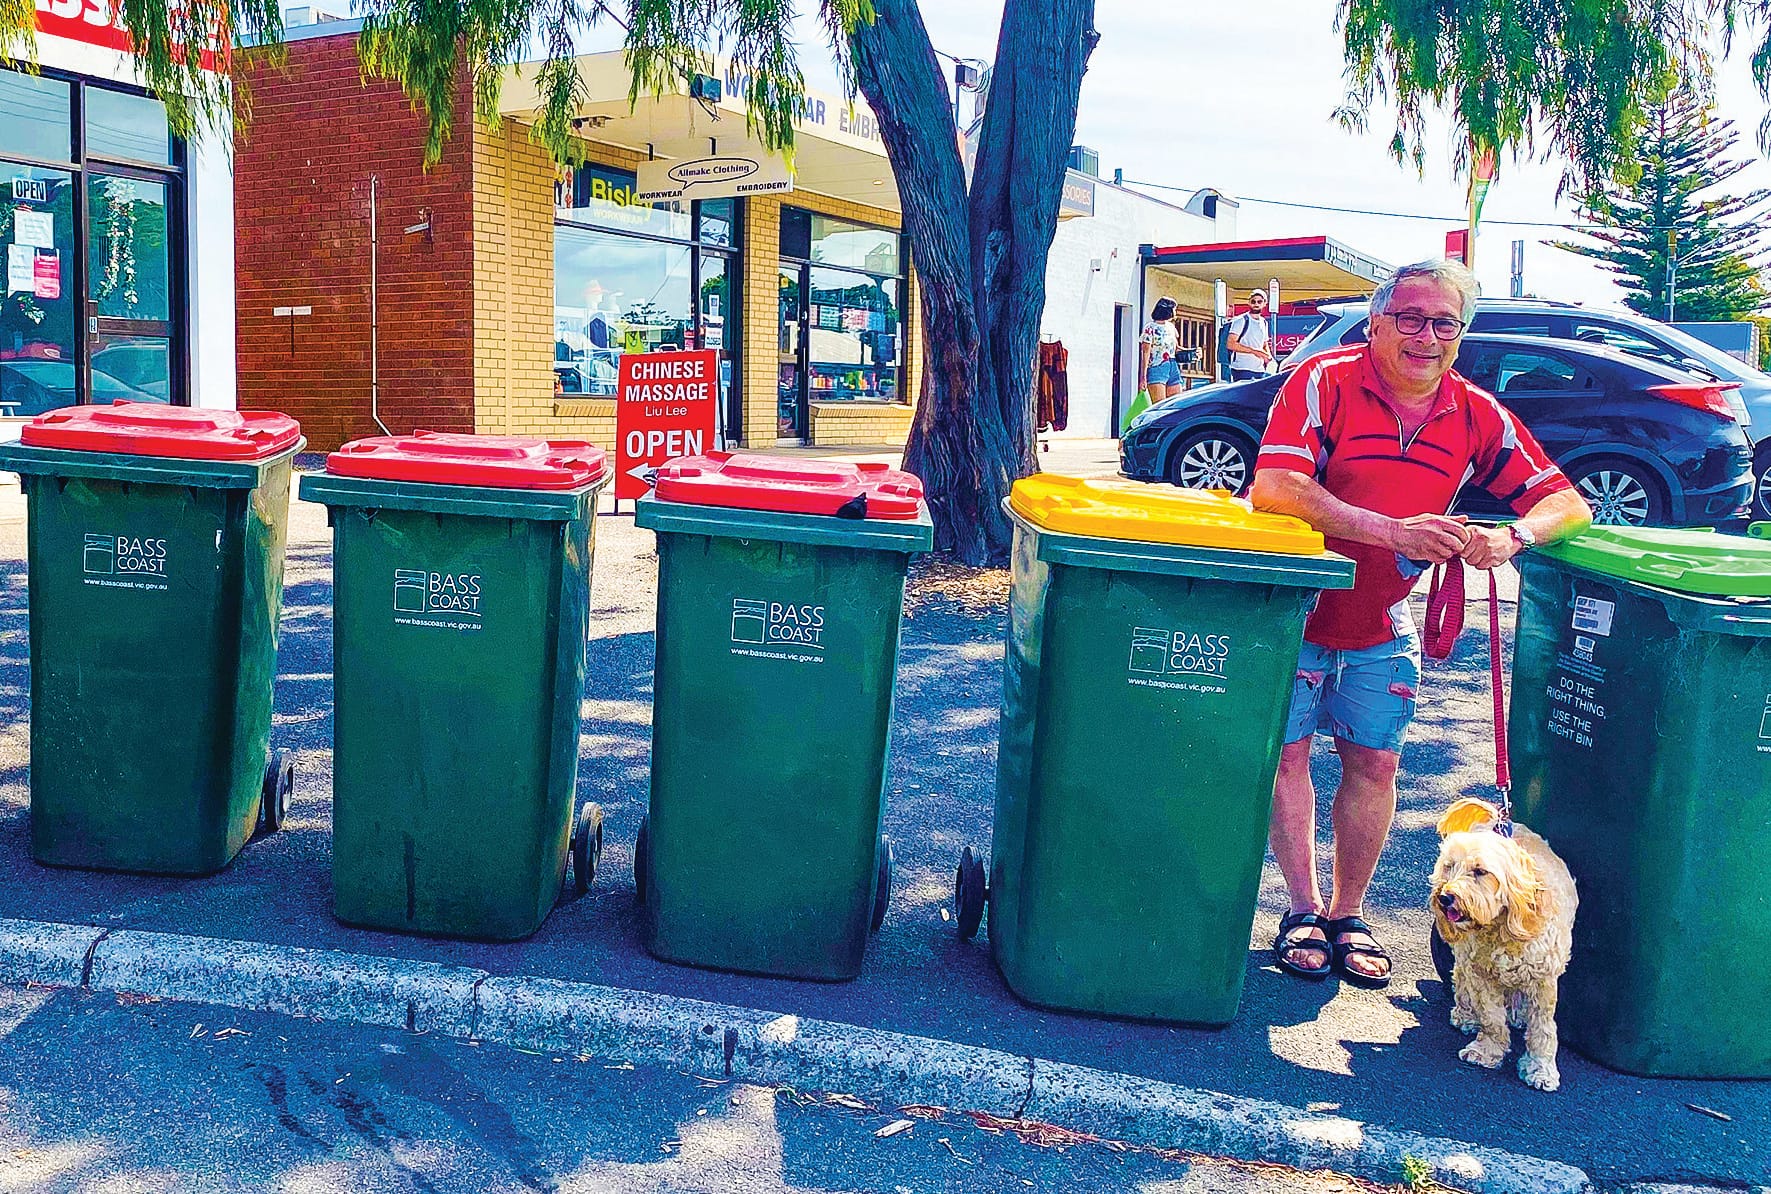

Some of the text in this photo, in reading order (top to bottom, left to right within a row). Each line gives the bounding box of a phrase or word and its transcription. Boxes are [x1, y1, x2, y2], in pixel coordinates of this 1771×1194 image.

[713, 164, 750, 175] Clothing
[16, 180, 45, 200] OPEN
[639, 181, 788, 200] WORKWEAR EMBROIDERY
[631, 361, 705, 380] CHINESE
[625, 382, 709, 402] MASSAGE
[645, 405, 688, 417] Liu Lee
[626, 429, 704, 458] OPEN
[117, 536, 168, 558] BASS
[117, 556, 167, 572] COAST
[429, 572, 481, 595] BASS
[429, 593, 480, 610] COAST
[394, 617, 482, 631] www.basscoast.vic.gov.au
[770, 602, 825, 627] BASS
[769, 624, 823, 642] COAST
[1172, 631, 1230, 657] BASS
[730, 648, 824, 663] www.basscoast.vic.gov.au
[1170, 653, 1227, 673] COAST
[1560, 676, 1596, 699] DO THE
[1546, 685, 1607, 720] RIGHT THING,
[1548, 720, 1575, 740] RIGHT
[1552, 708, 1593, 733] USE THE
